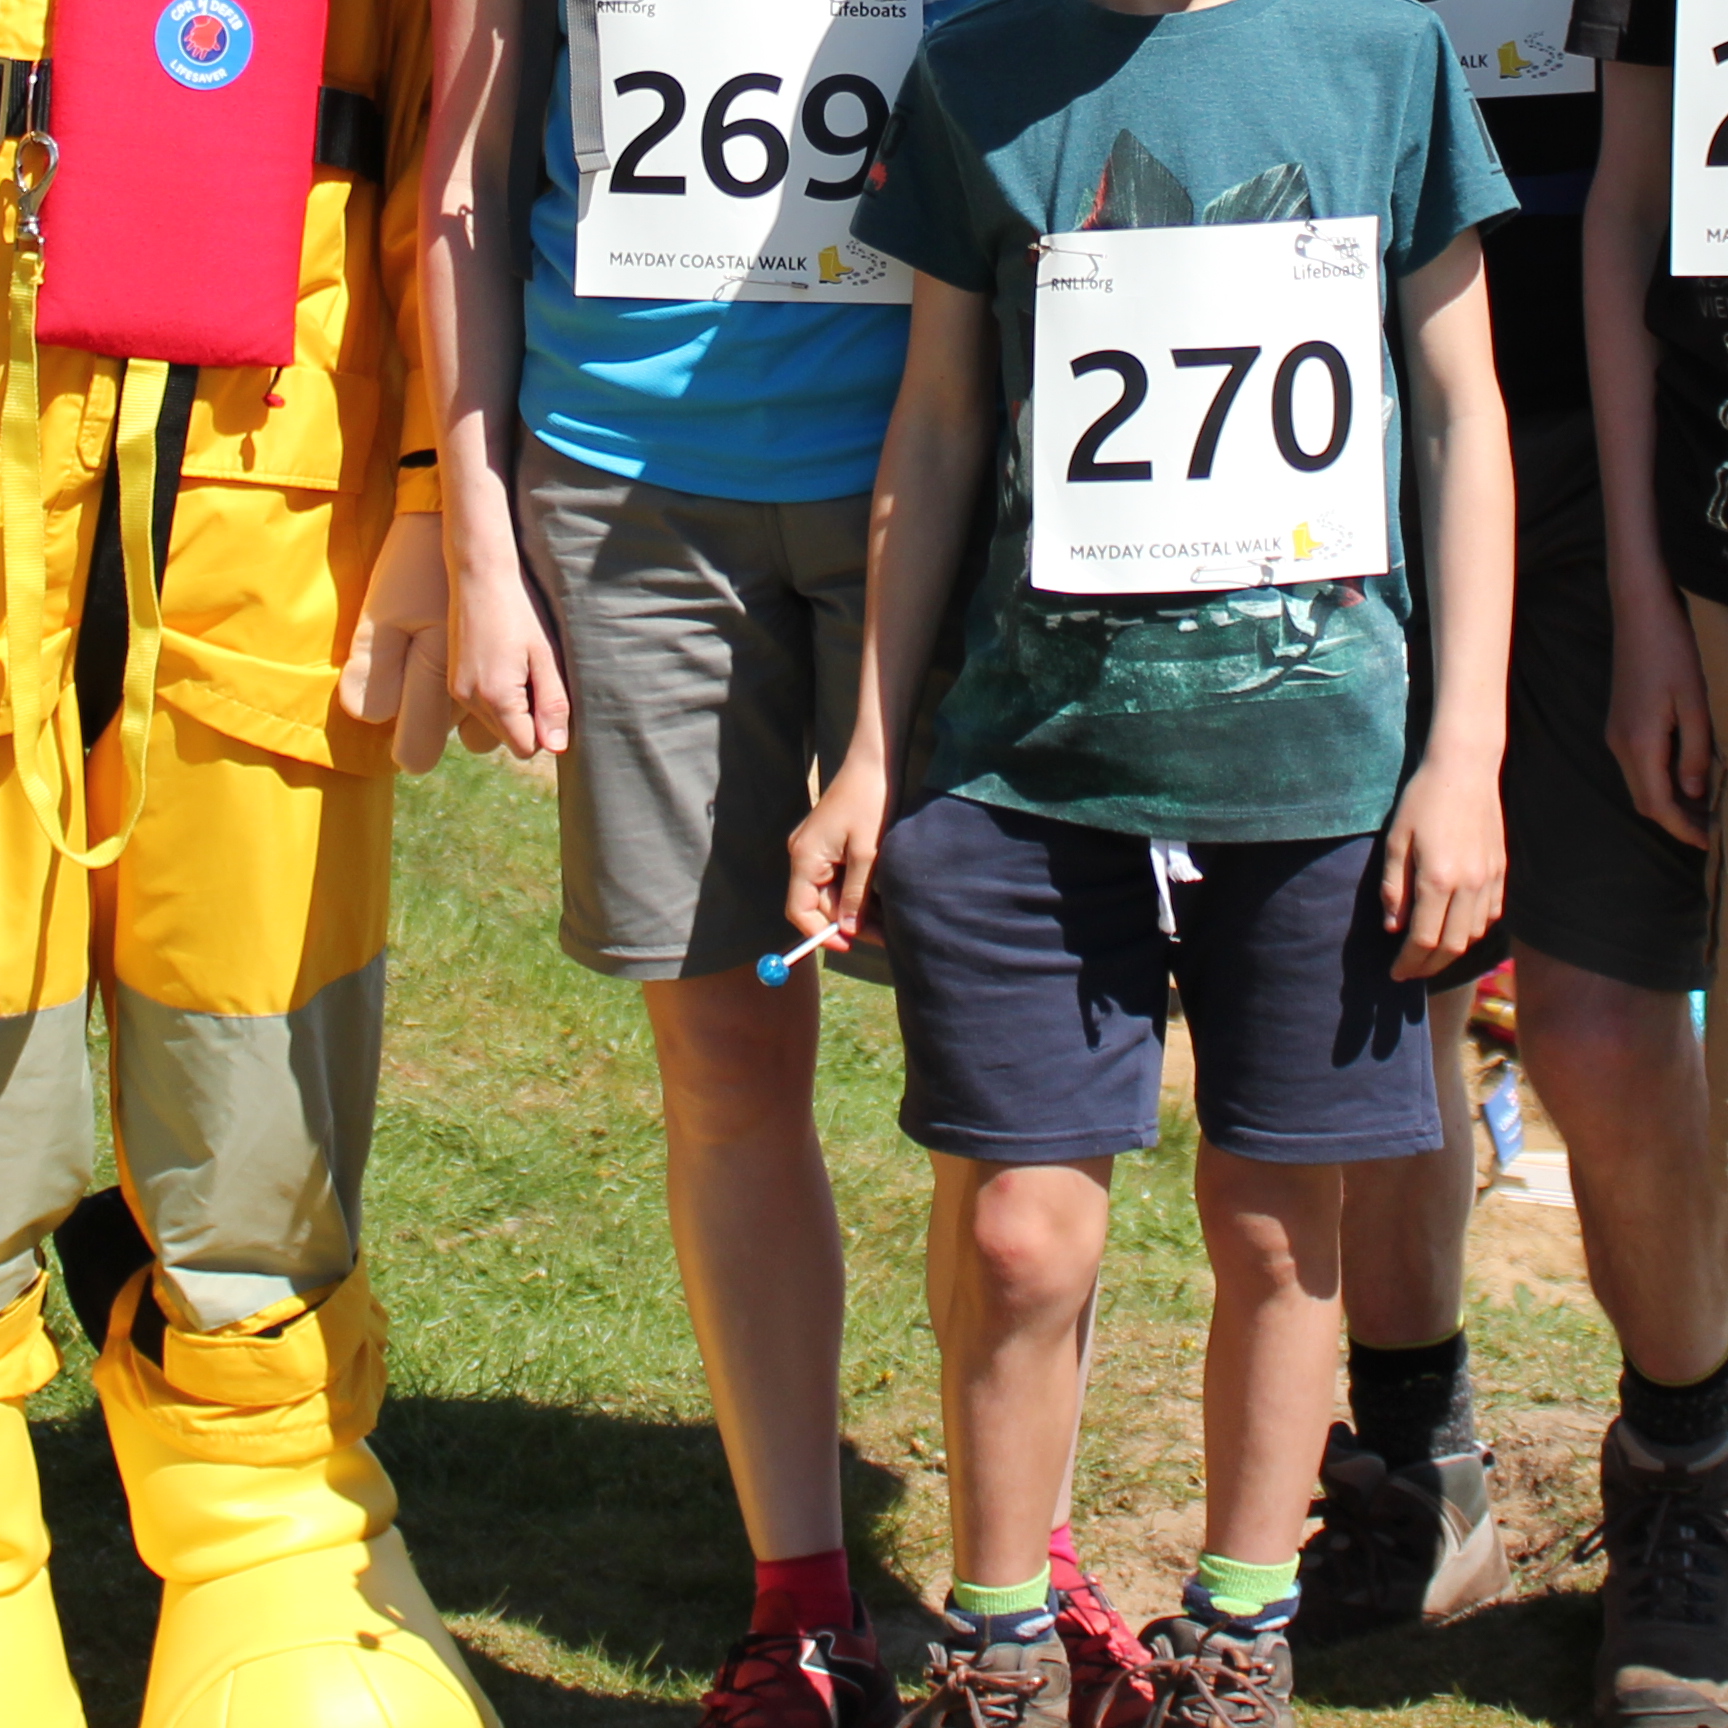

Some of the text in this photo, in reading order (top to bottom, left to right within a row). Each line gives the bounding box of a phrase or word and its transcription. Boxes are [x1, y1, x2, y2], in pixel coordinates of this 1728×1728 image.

[170, 0, 196, 22] CPR
[209, 0, 245, 31] DEFIB
[597, 1, 656, 18] RNLI.org
[829, 1, 908, 19] Lifeboats
[169, 58, 228, 84] LIFESAVER
[608, 70, 891, 202] 269
[609, 251, 808, 271] MAYDAY COASTAL WALK
[1293, 262, 1365, 281] Lifeboats
[1051, 277, 1114, 293] RNLI.org
[1067, 340, 1354, 483] 270
[1070, 537, 1282, 560] MAYDAY COASTAL WALK
